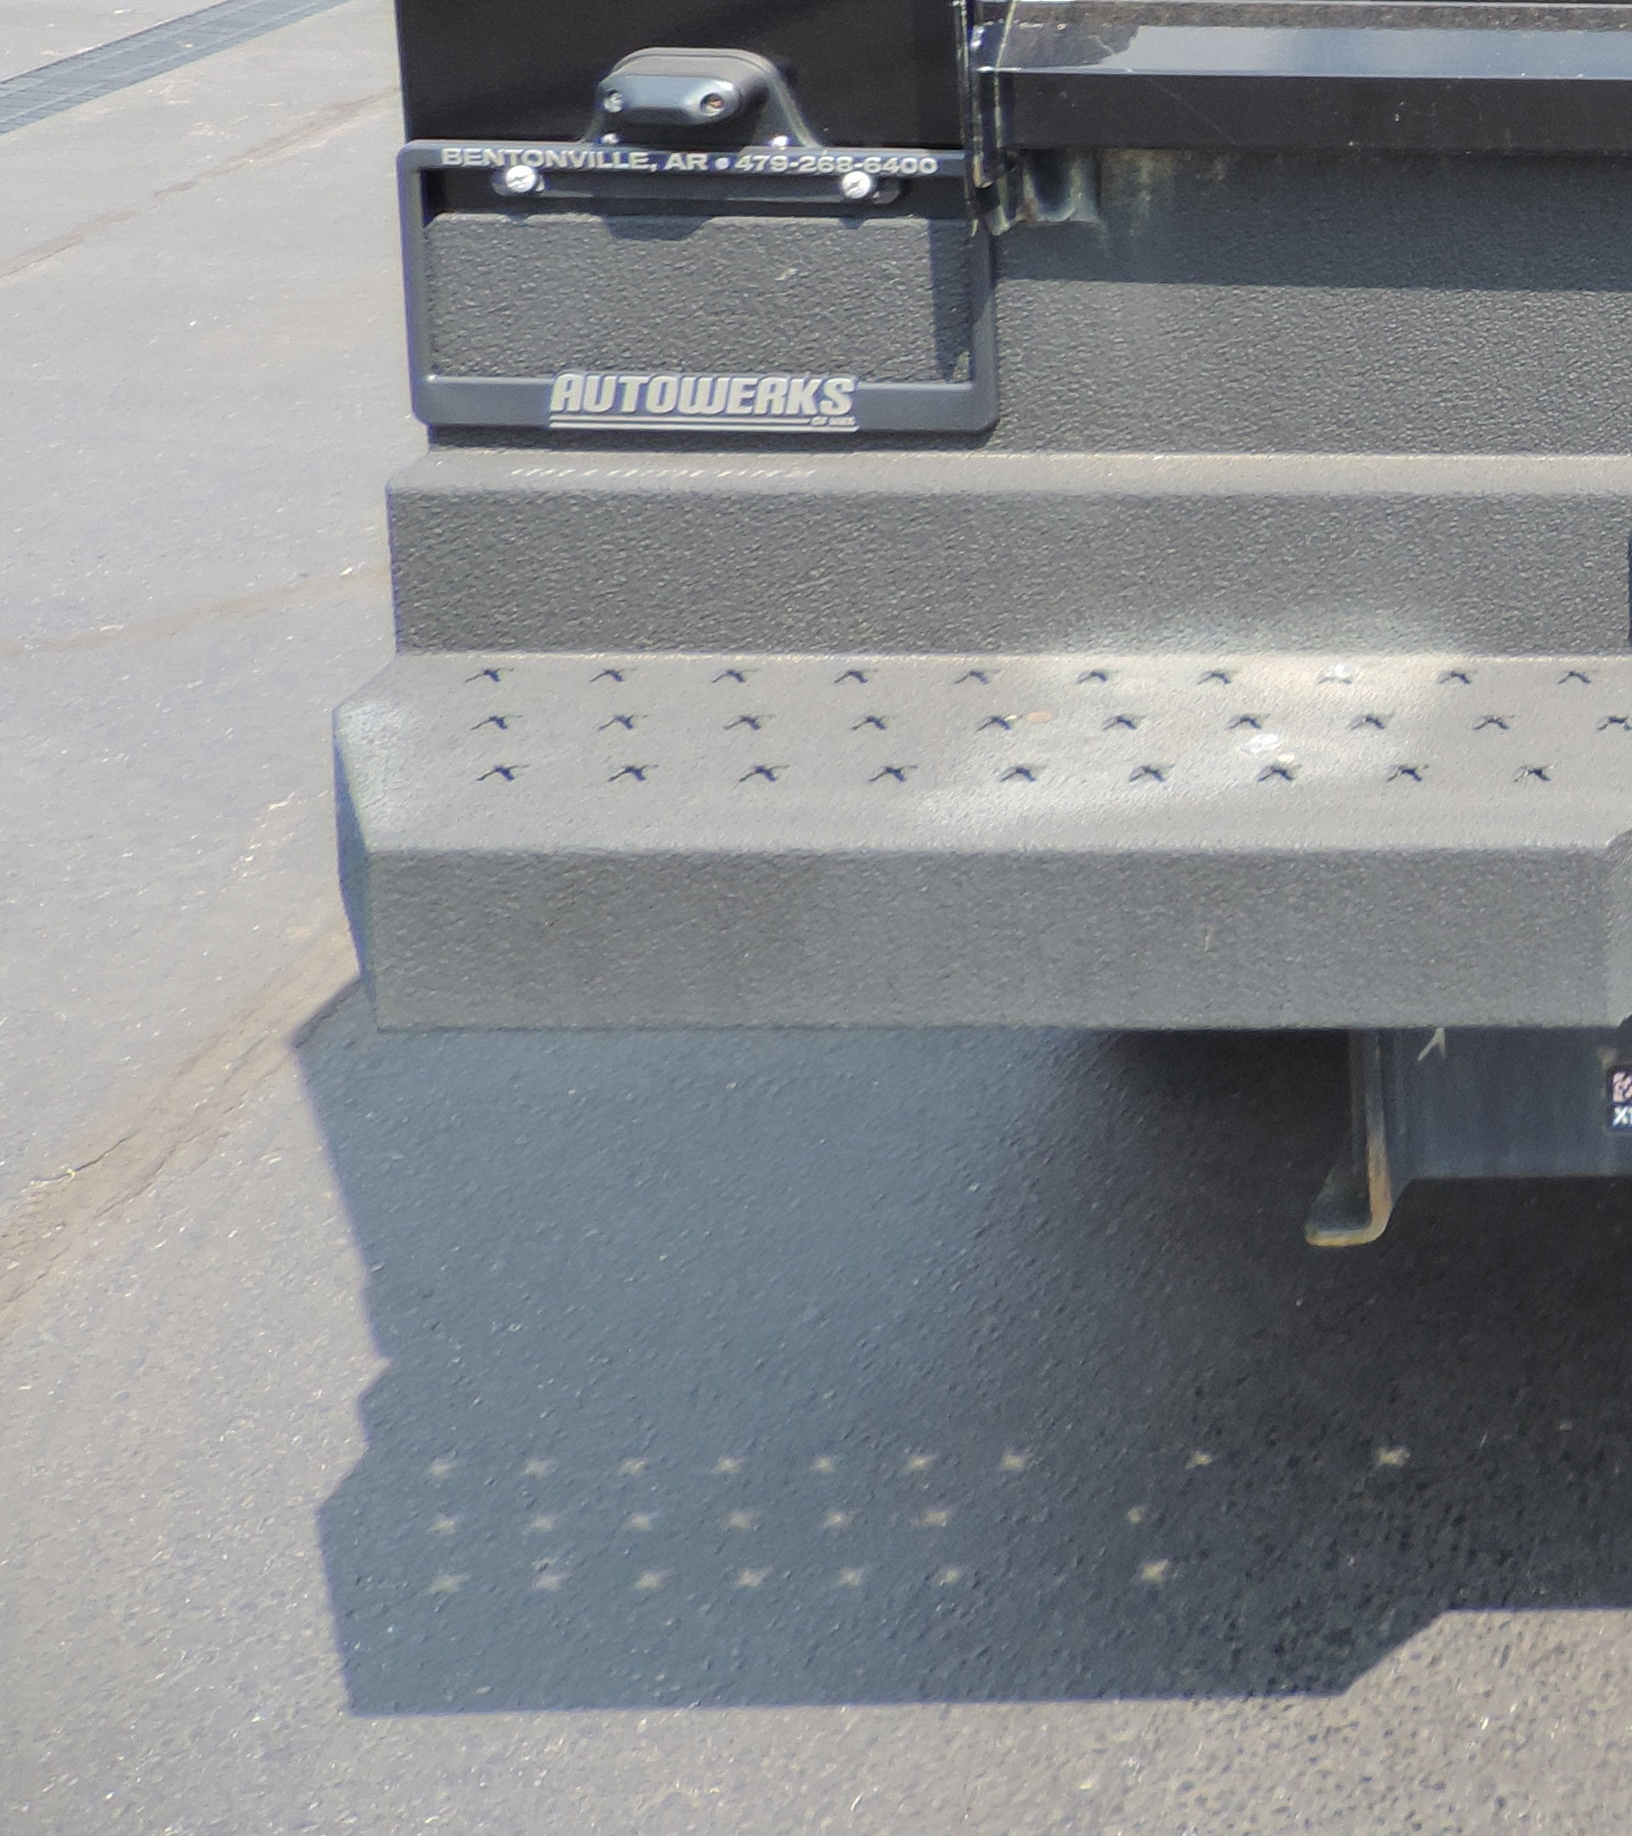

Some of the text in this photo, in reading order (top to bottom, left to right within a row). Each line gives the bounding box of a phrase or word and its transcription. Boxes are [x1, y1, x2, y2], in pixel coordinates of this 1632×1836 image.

[440, 147, 939, 175] BENTONVILLE, AR 479-268-6400
[549, 373, 855, 416] AUTOWERKS
